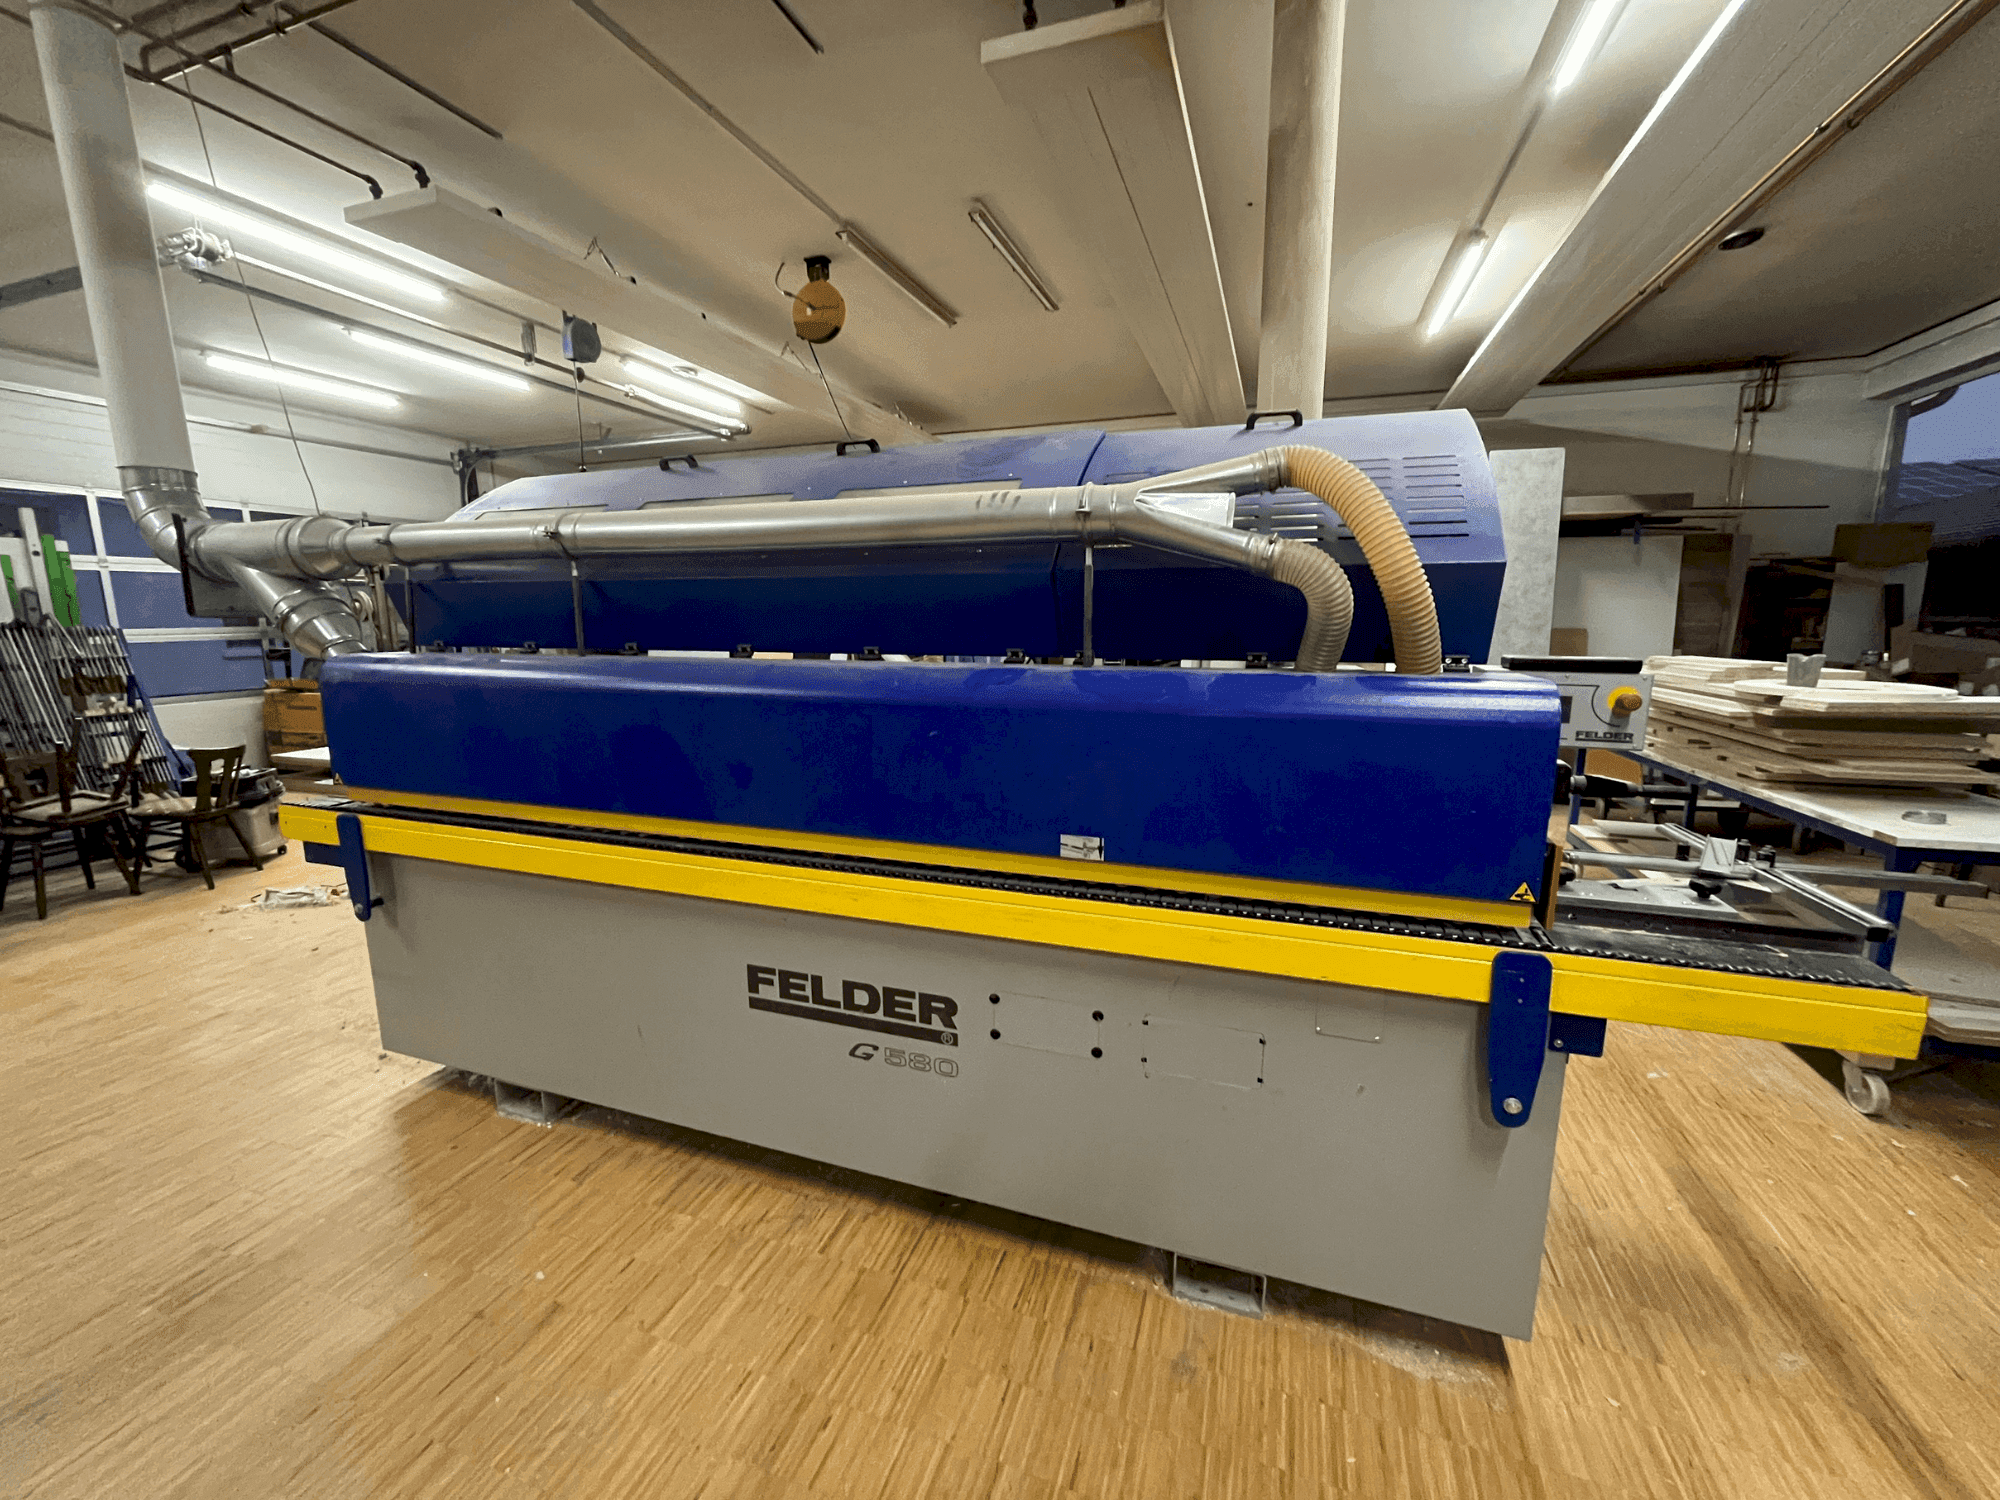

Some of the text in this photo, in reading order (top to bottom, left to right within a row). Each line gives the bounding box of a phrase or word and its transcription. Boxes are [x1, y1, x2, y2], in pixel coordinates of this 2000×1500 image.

[1575, 730, 1634, 740] FELDER
[747, 964, 958, 1030] FELDER
[848, 1042, 959, 1078] G 580
